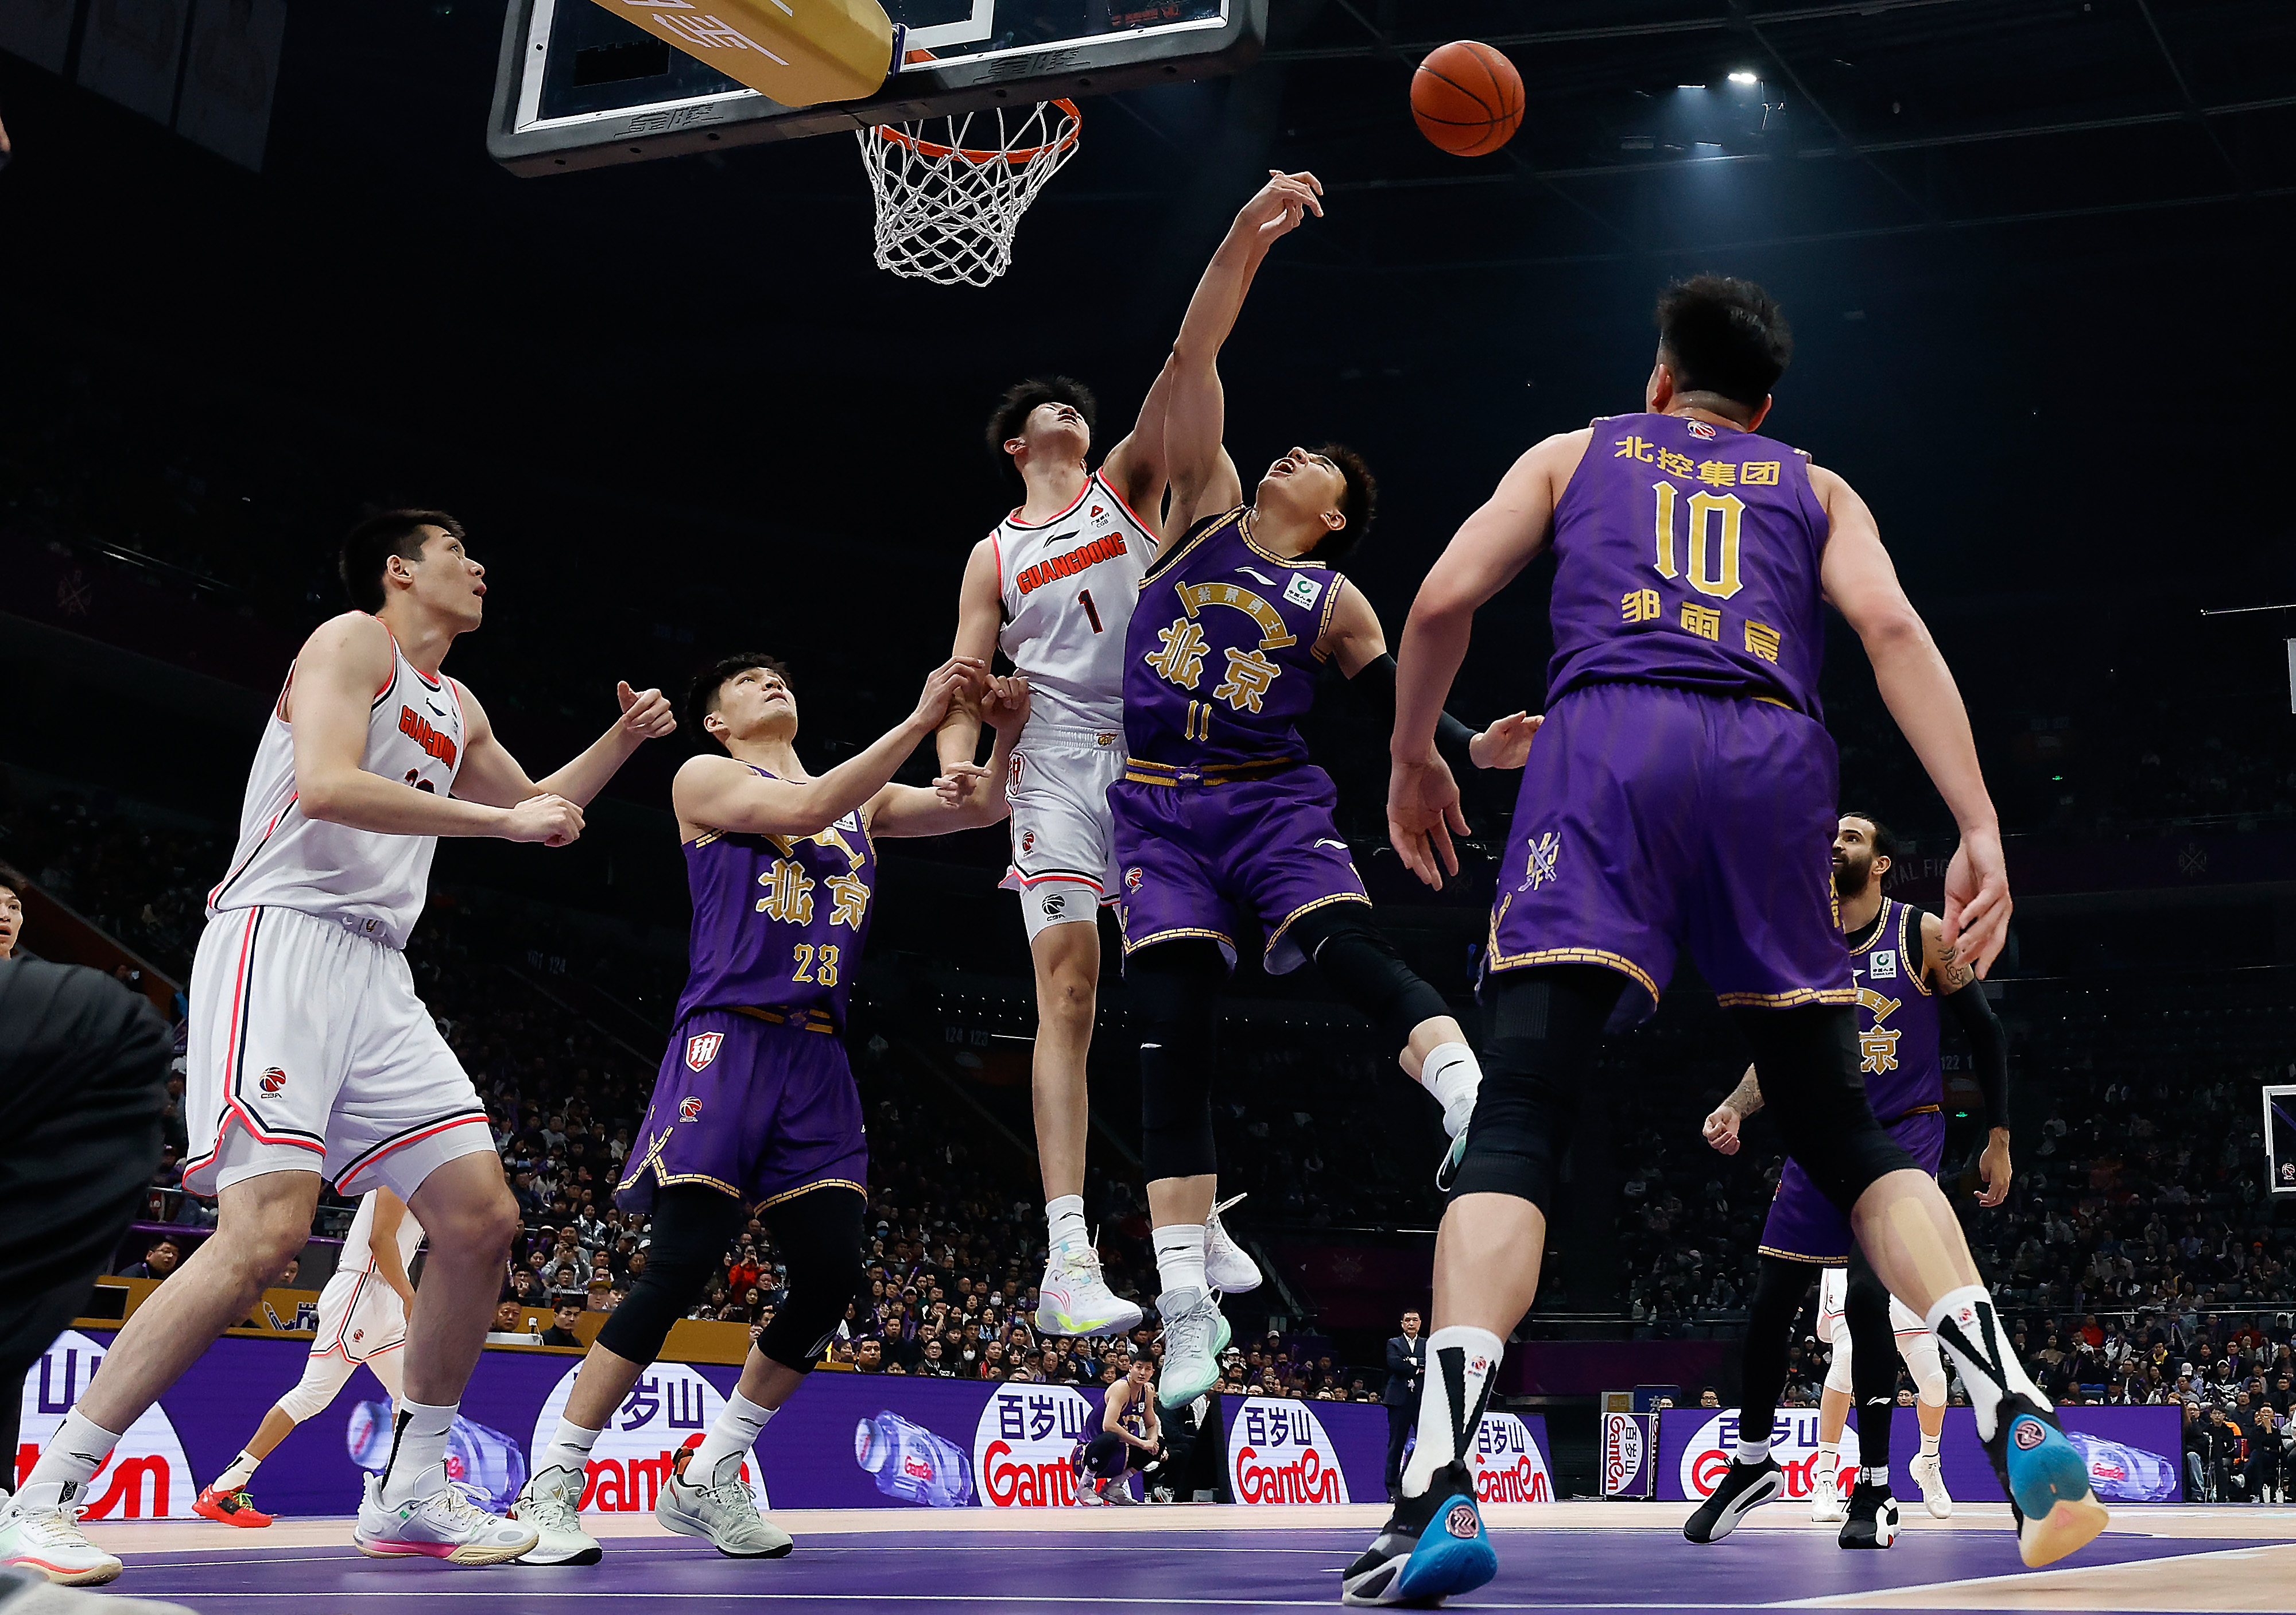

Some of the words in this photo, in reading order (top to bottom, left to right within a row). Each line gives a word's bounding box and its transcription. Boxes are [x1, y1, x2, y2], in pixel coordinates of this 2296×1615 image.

[1614, 436, 1782, 487] 北控集团
[1015, 531, 1127, 595] GUANGDONG
[1653, 480, 1746, 600] 10
[1077, 589, 1103, 634] 1
[1145, 617, 1281, 713] 北京
[1185, 700, 1212, 741] 11
[755, 859, 870, 933] 北京
[792, 943, 840, 987] 23
[574, 1373, 704, 1431] 岁山
[997, 1394, 1085, 1441] 百岁山
[1244, 1407, 1312, 1447] 百岁山
[1477, 1420, 1525, 1455] 百岁山
[1625, 1427, 1637, 1474] 百岁山
[984, 1440, 1110, 1507] Gant
